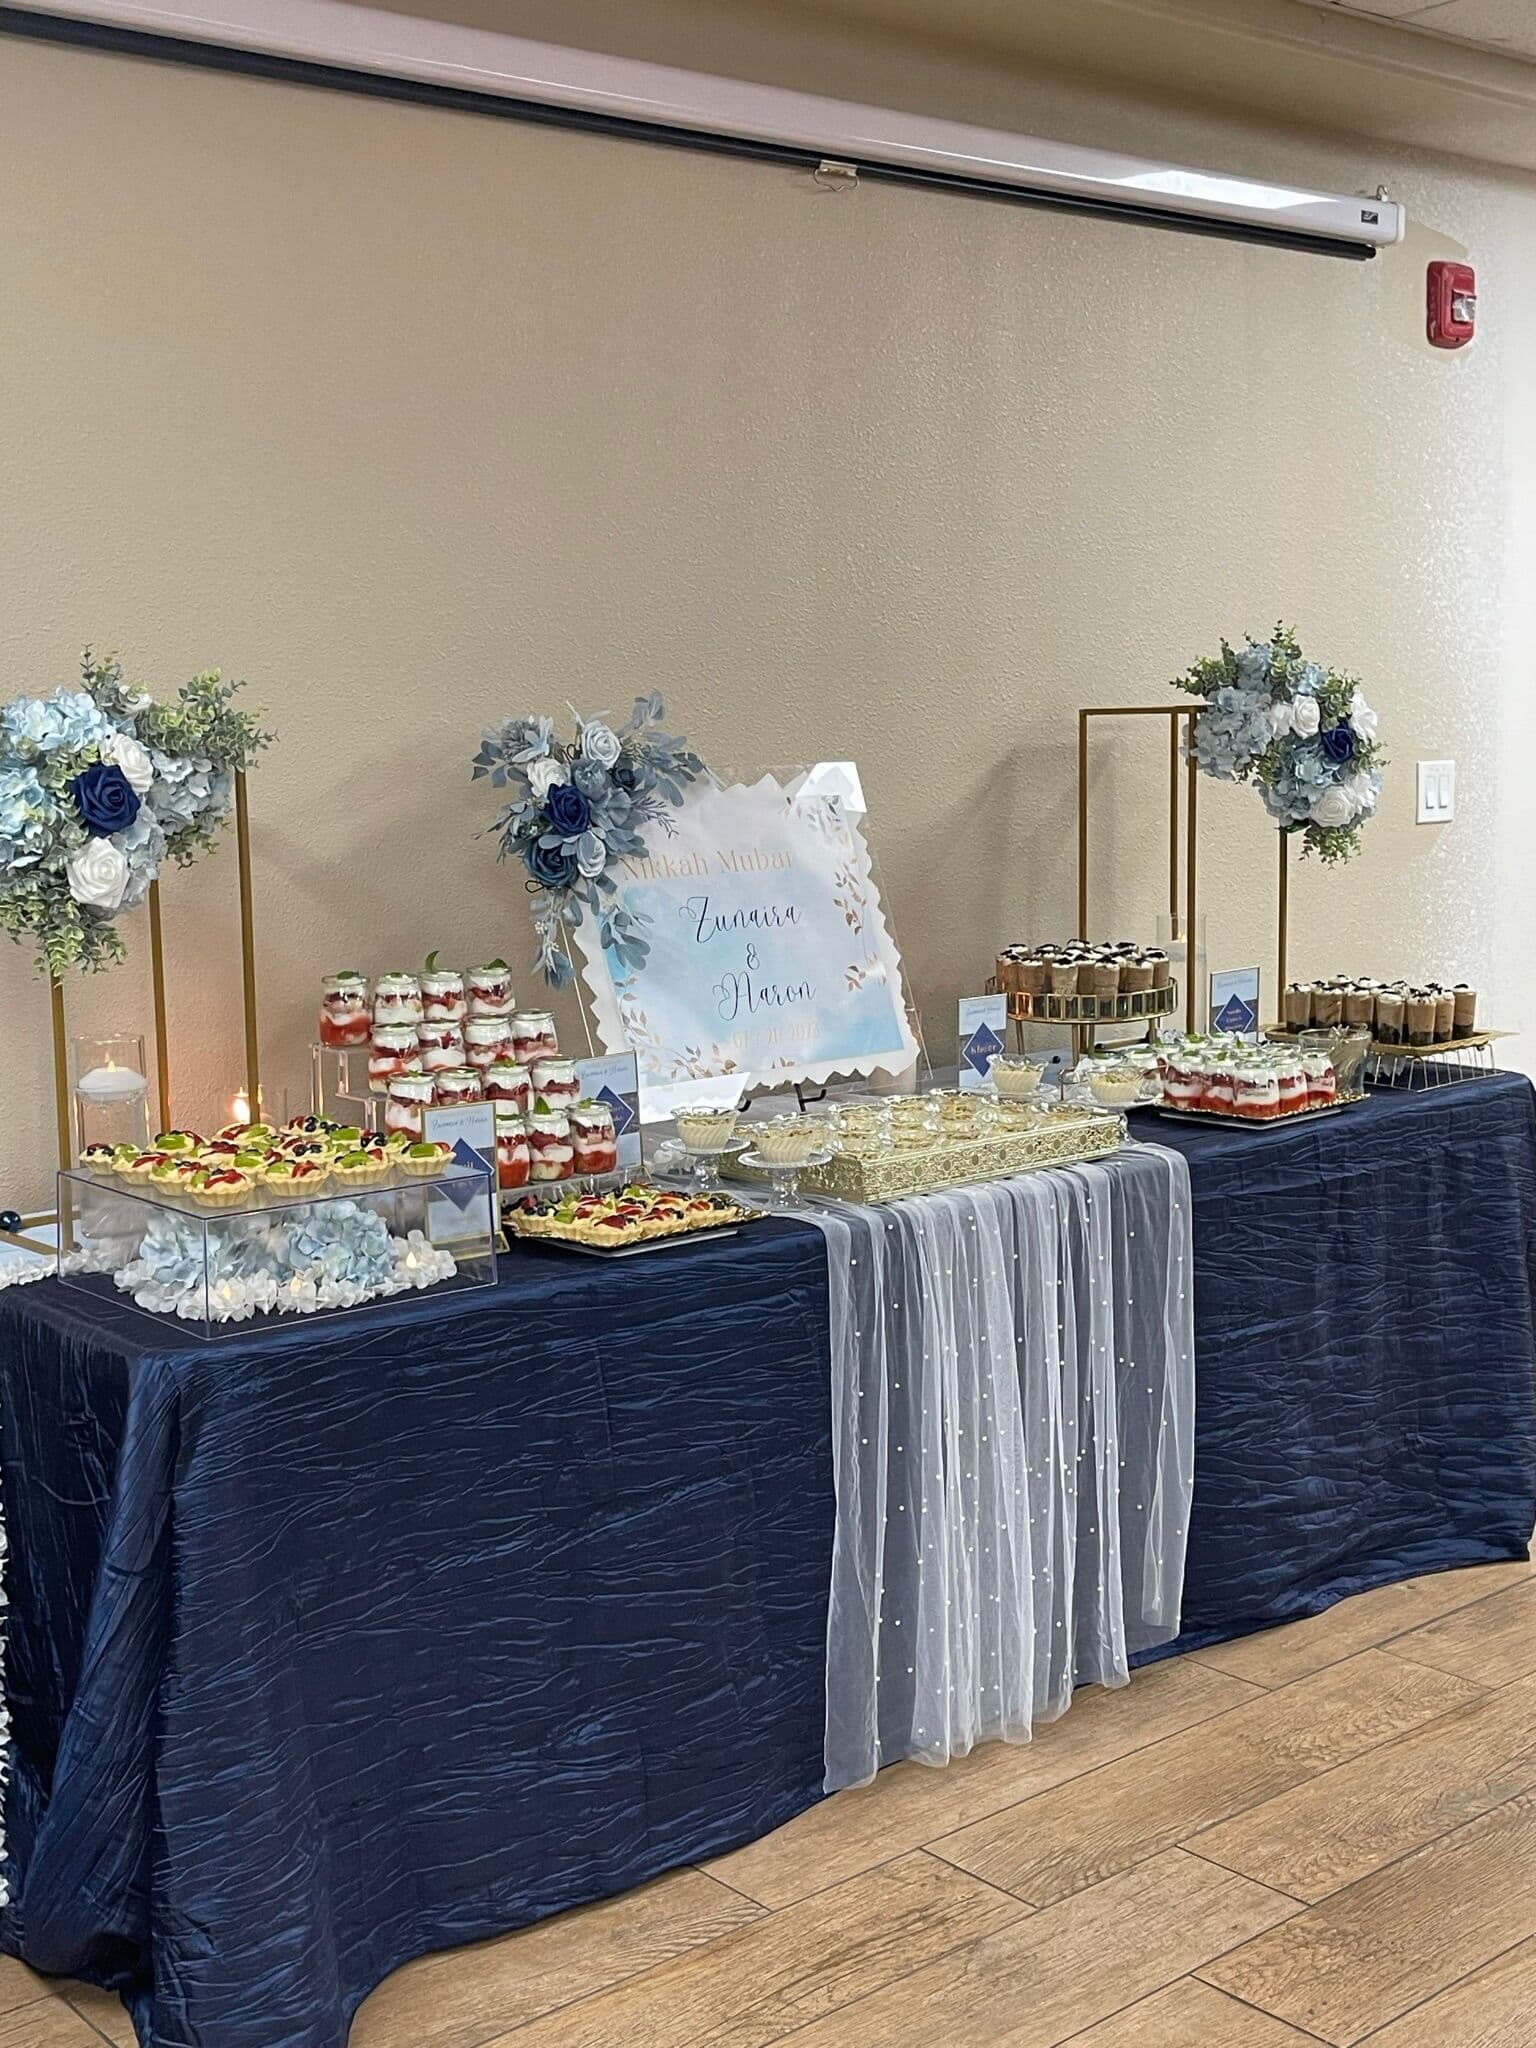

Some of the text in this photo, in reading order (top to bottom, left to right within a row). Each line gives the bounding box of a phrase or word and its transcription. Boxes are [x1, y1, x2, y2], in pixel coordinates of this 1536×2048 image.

[619, 852, 709, 881] Nikkah
[679, 896, 801, 943] Zunaira
[746, 942, 760, 970] &
[712, 971, 816, 1021] Haron
